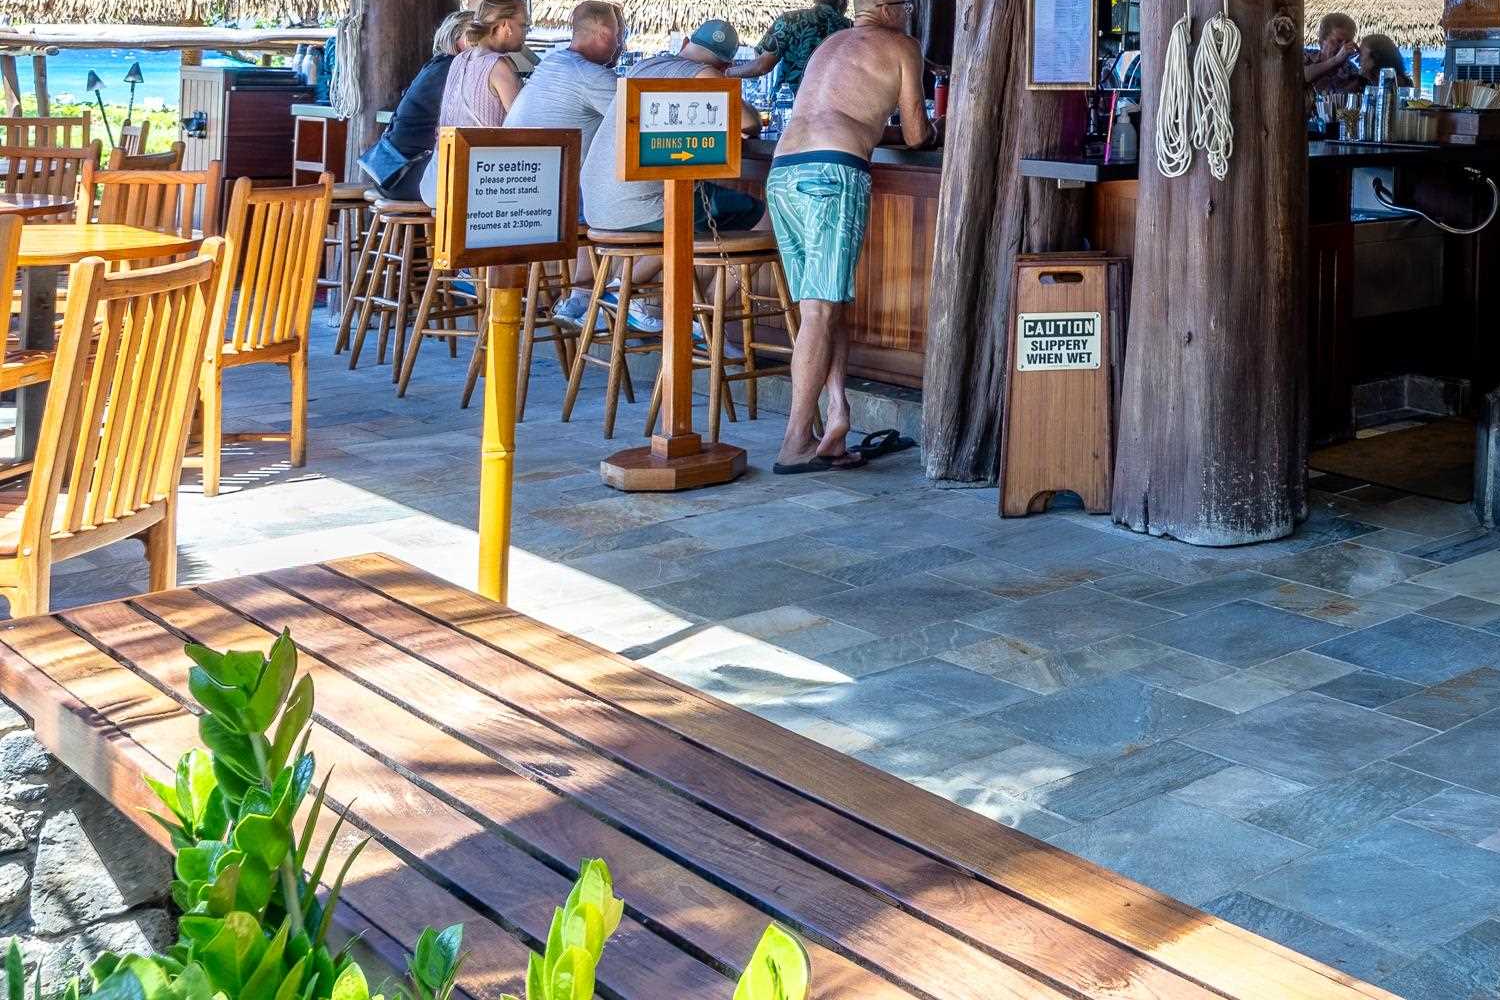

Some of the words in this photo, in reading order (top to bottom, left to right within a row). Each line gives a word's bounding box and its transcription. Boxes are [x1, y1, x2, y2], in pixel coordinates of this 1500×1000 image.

[651, 137, 682, 150] DRINKS
[686, 137, 697, 149] TO
[702, 136, 715, 148] GO
[476, 161, 495, 173] For
[498, 160, 541, 173] seating:
[480, 176, 505, 185] please
[506, 175, 537, 184] proceed
[475, 188, 483, 196] to
[485, 187, 498, 196] the
[500, 187, 516, 195] host
[518, 185, 540, 195] stand.
[495, 209, 508, 218] Bar
[510, 207, 552, 217] self-seating
[469, 222, 501, 231] resumes
[503, 221, 511, 229] at
[512, 219, 543, 229] 2:30pm.
[1025, 320, 1094, 335] CAUTION
[1031, 339, 1088, 351] SLIPPERY
[1026, 353, 1063, 365] WHEN
[1067, 352, 1092, 364] WET
